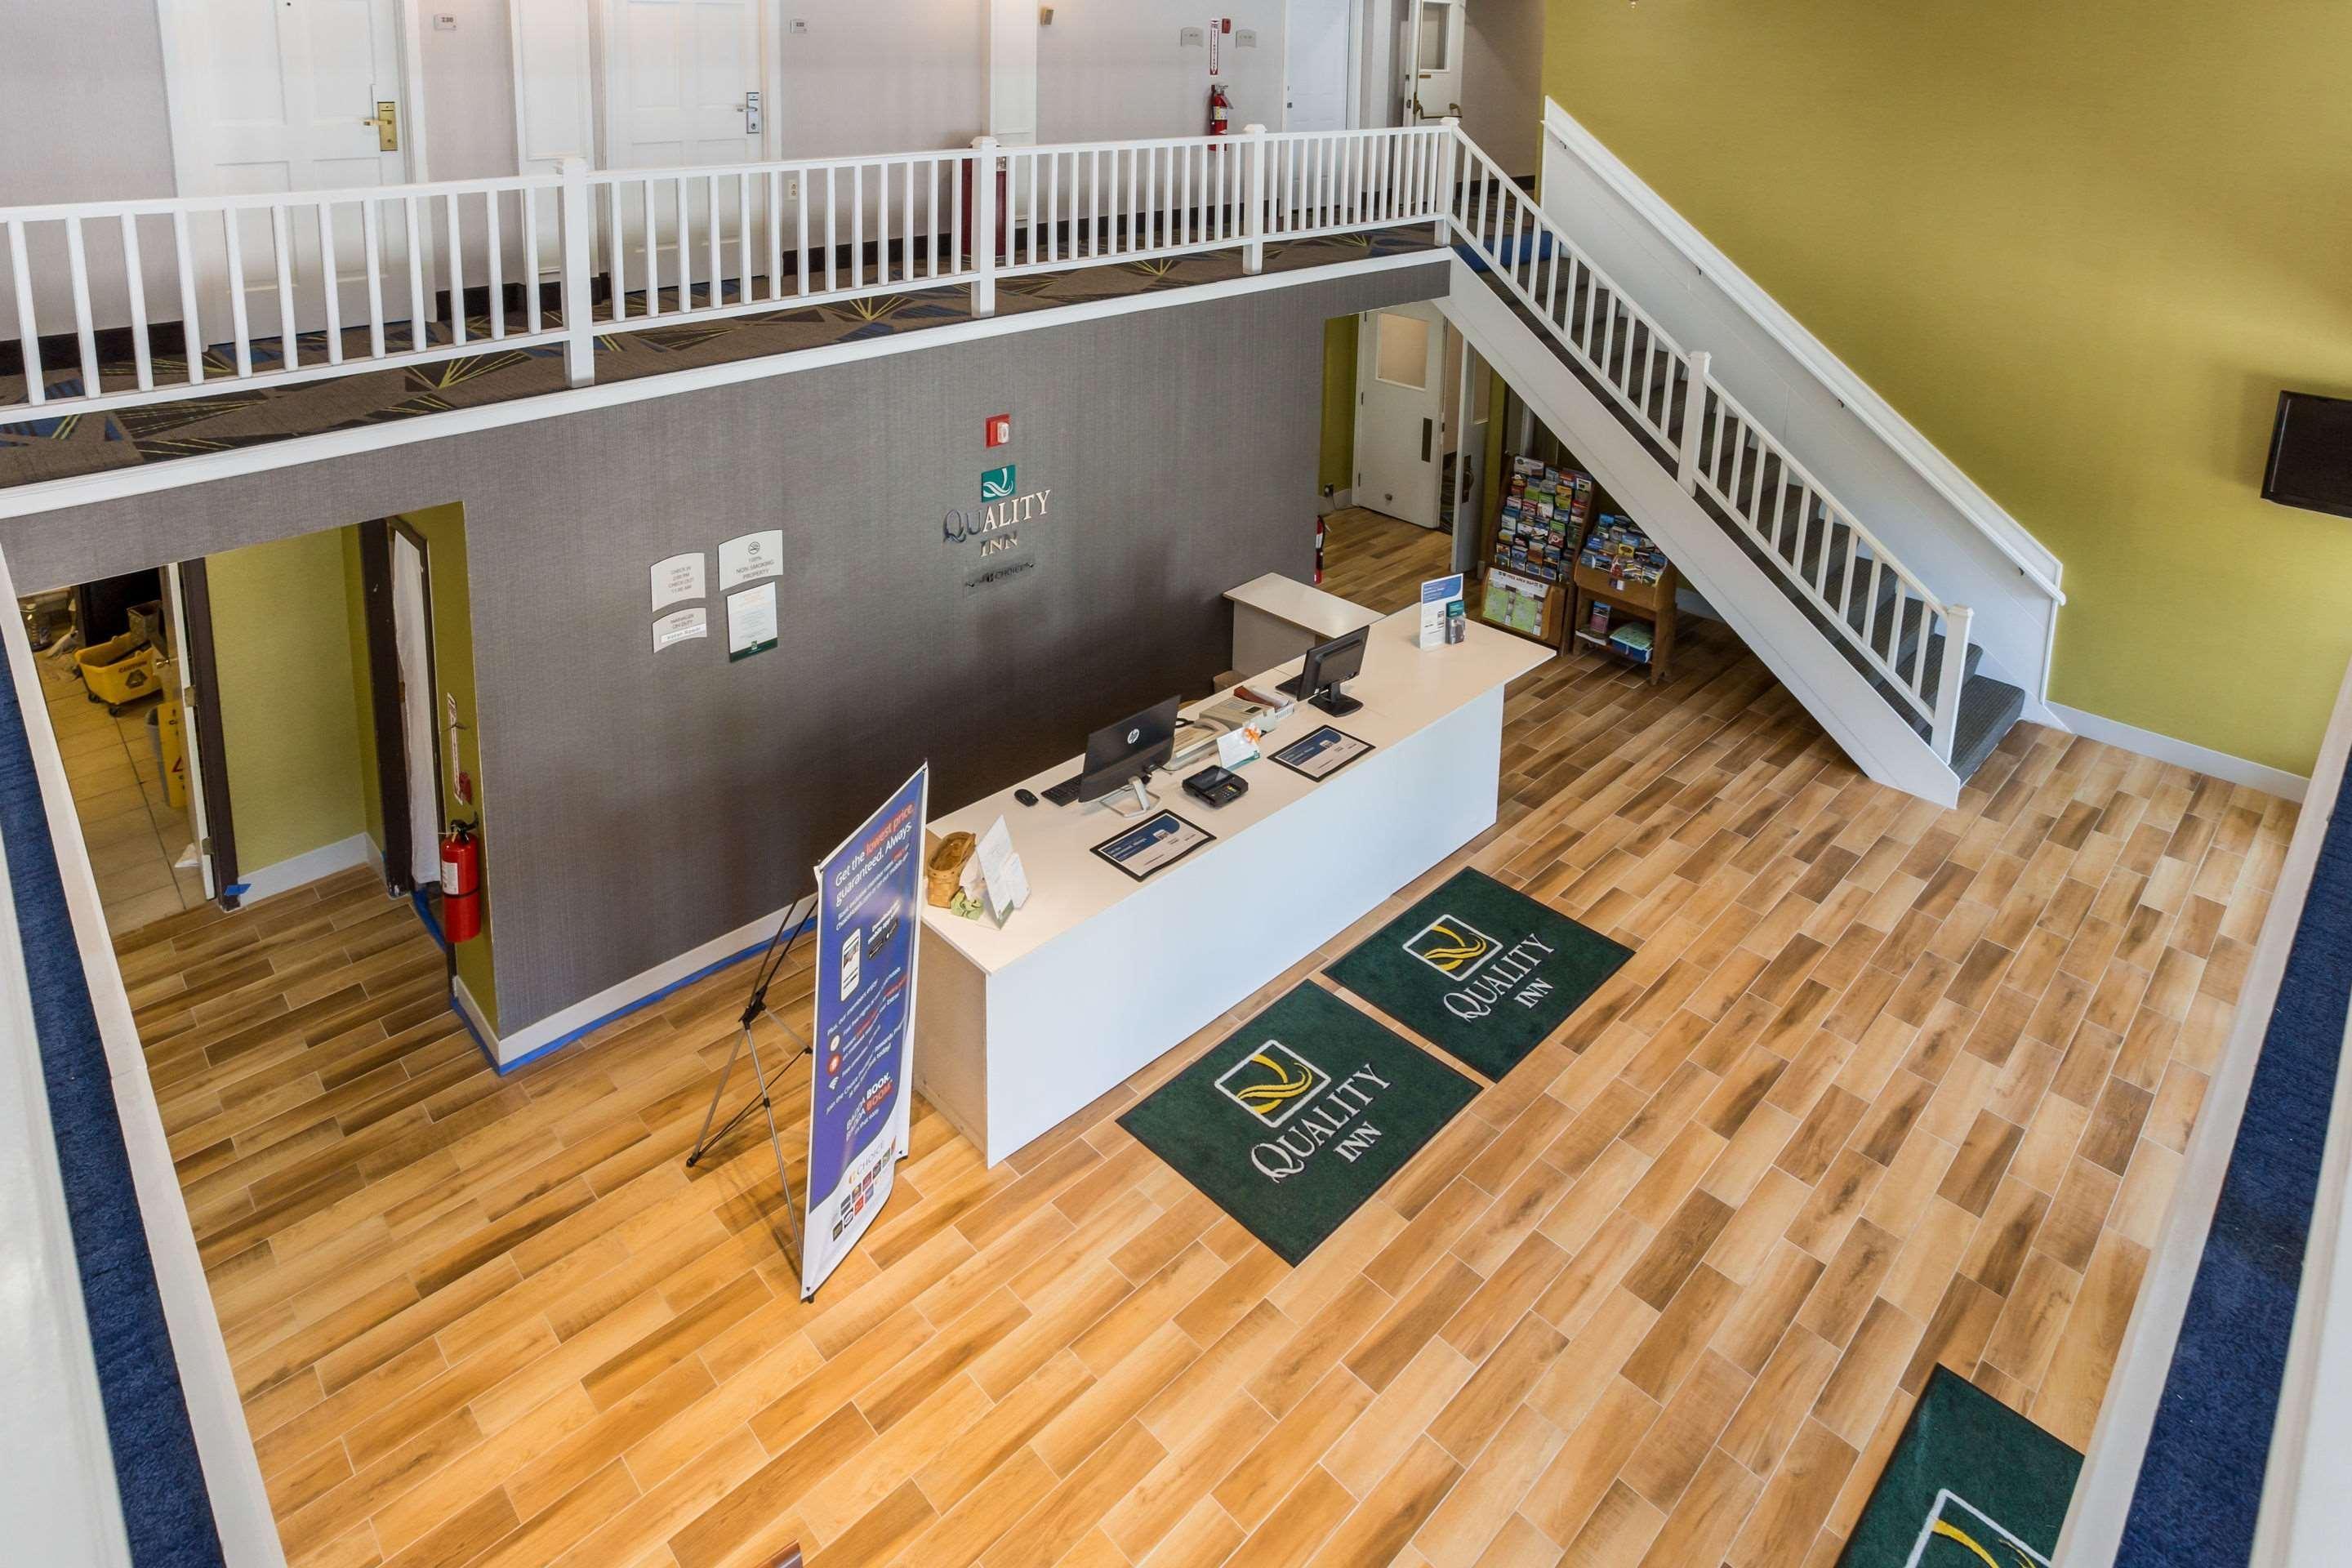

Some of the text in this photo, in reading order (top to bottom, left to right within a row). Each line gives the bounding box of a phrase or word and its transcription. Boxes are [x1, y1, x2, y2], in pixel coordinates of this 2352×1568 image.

[942, 490, 1051, 543] QUALITY
[981, 530, 1018, 557] INN
[118, 660, 148, 674] CAUTION
[835, 866, 851, 887] Get
[852, 852, 865, 871] the
[866, 822, 893, 857] lowest
[835, 848, 884, 908] guaranteed.
[1442, 932, 1556, 1023] QUALITY
[1513, 977, 1556, 1009] INN
[1250, 1062, 1392, 1184] QUALITY
[1332, 1120, 1383, 1165] INN
